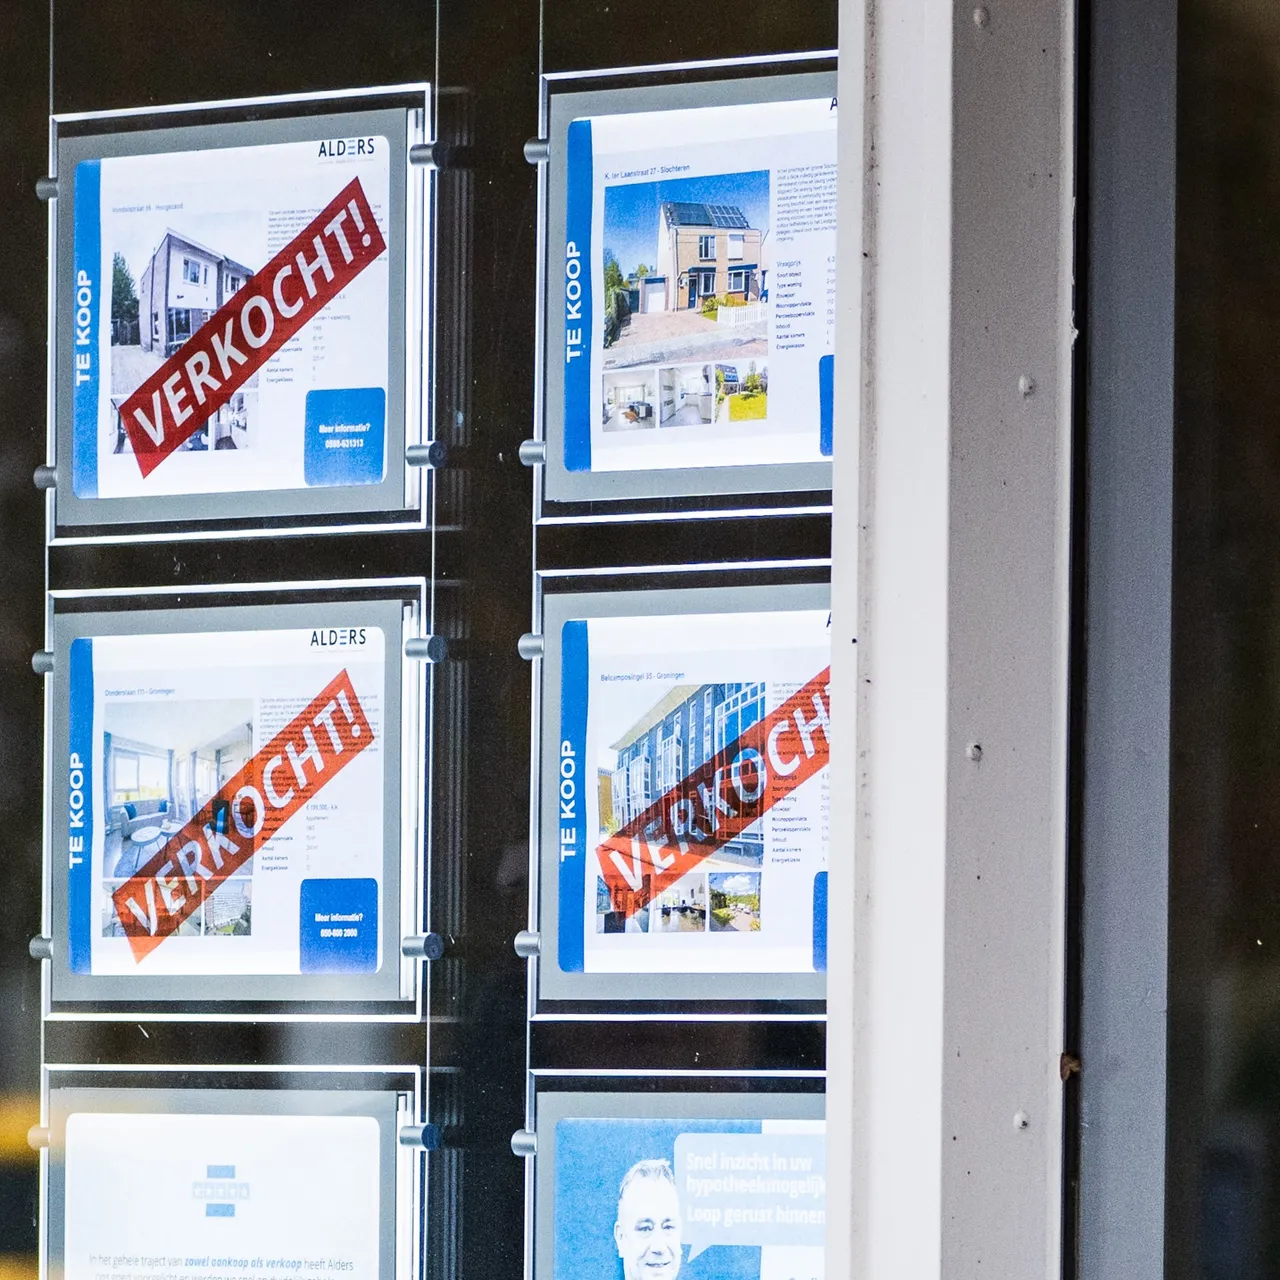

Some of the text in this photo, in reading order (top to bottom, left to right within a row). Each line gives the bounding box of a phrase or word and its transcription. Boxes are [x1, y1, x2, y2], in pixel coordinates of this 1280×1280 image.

[318, 138, 375, 157] ALDERS
[660, 165, 690, 174] Slochteren
[566, 241, 581, 363] TE KOOP
[76, 270, 92, 386] TE KOOP
[133, 199, 371, 448] VERKOCHT!
[319, 423, 371, 433] Meer informatie?
[310, 629, 366, 646] ALDERS
[657, 672, 686, 680] Groningen
[69, 752, 84, 869] TE KOOP
[560, 740, 577, 862] TE KOOP
[125, 688, 361, 937] VERKOCHT!
[315, 912, 364, 922] Meer informatie?
[686, 1151, 813, 1171] Snel inzicht in uw
[687, 1205, 721, 1228] Loop
[724, 1206, 774, 1228] gerust
[99, 1254, 111, 1266] het
[113, 1255, 139, 1269] gehele
[141, 1255, 166, 1270] traject
[168, 1258, 183, 1267] van
[184, 1256, 209, 1267] zowel
[211, 1257, 249, 1270] aankoop
[251, 1257, 263, 1268] als
[266, 1258, 302, 1272] verkoop
[304, 1258, 325, 1270] heeft
[328, 1259, 354, 1271] Alders
